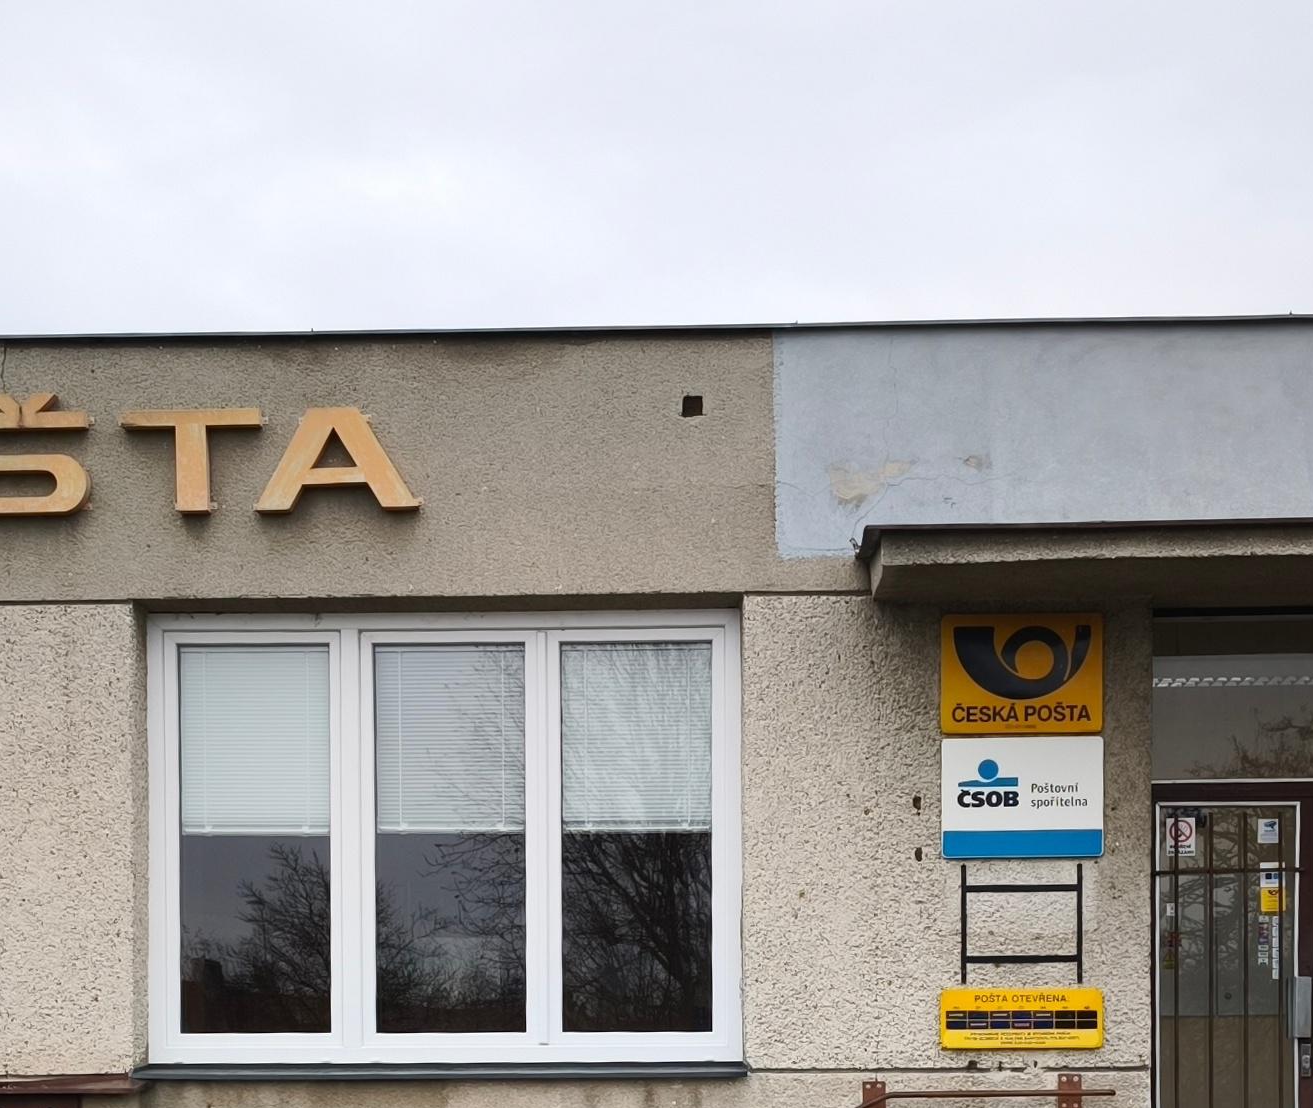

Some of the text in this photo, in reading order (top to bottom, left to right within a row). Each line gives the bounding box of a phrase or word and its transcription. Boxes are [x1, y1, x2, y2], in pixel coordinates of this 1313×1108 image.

[951, 702, 1091, 722] ČESKÁ POŠTA
[1030, 783, 1079, 794] Poštovní
[957, 789, 1019, 808] ČSOB
[1030, 796, 1088, 809] spořitelna
[974, 992, 1067, 1003] POŠTA OTEVŘENA
